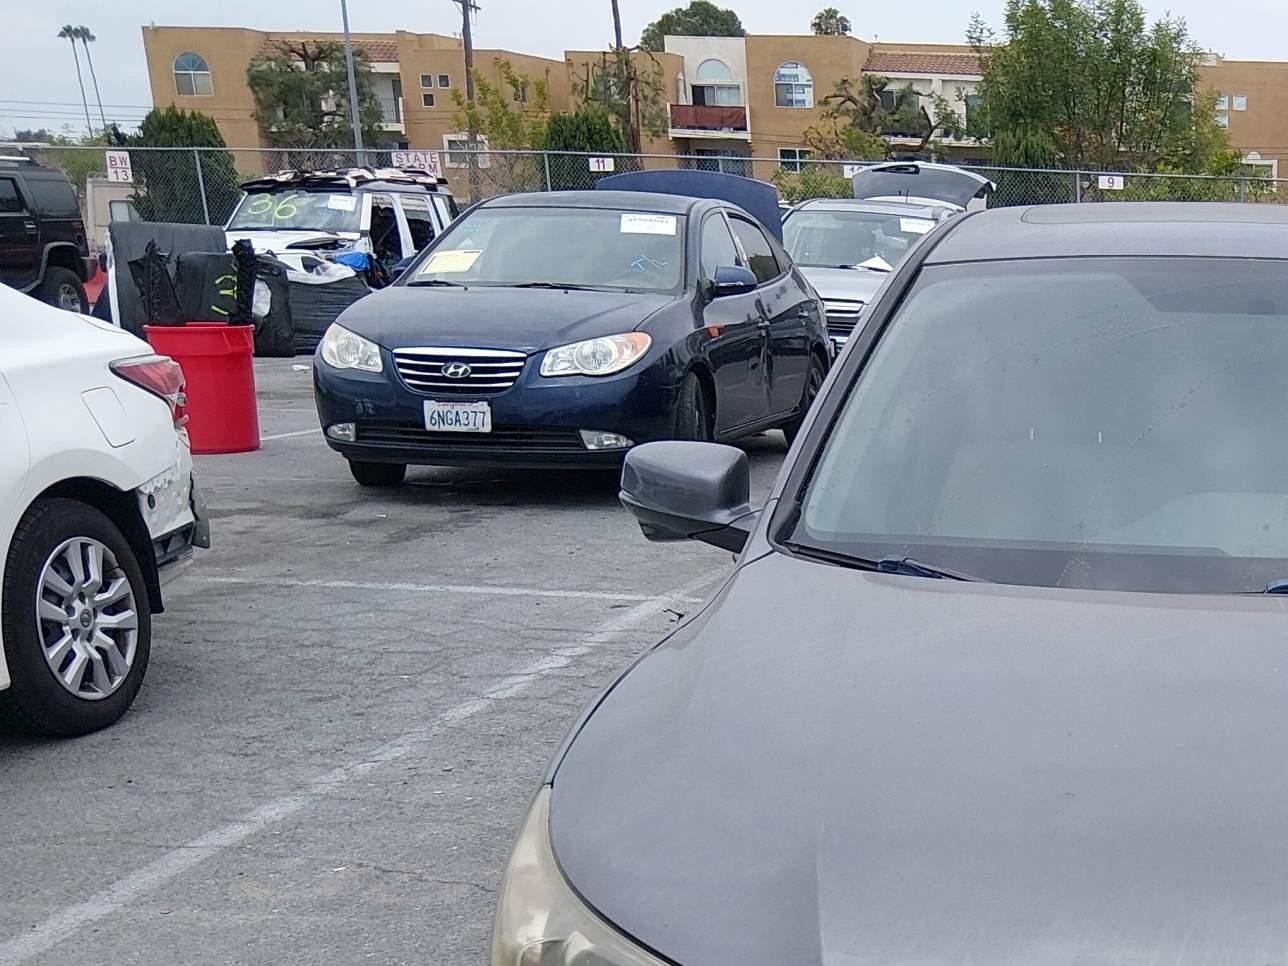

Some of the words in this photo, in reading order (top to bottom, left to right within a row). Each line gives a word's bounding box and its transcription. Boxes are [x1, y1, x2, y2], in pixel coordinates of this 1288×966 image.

[109, 156, 127, 167] BW
[396, 152, 438, 163] STATE
[595, 159, 605, 170] 11
[114, 170, 129, 181] 13
[1107, 176, 1115, 188] 9
[249, 193, 298, 219] 36
[430, 410, 486, 427] 6NGA377
